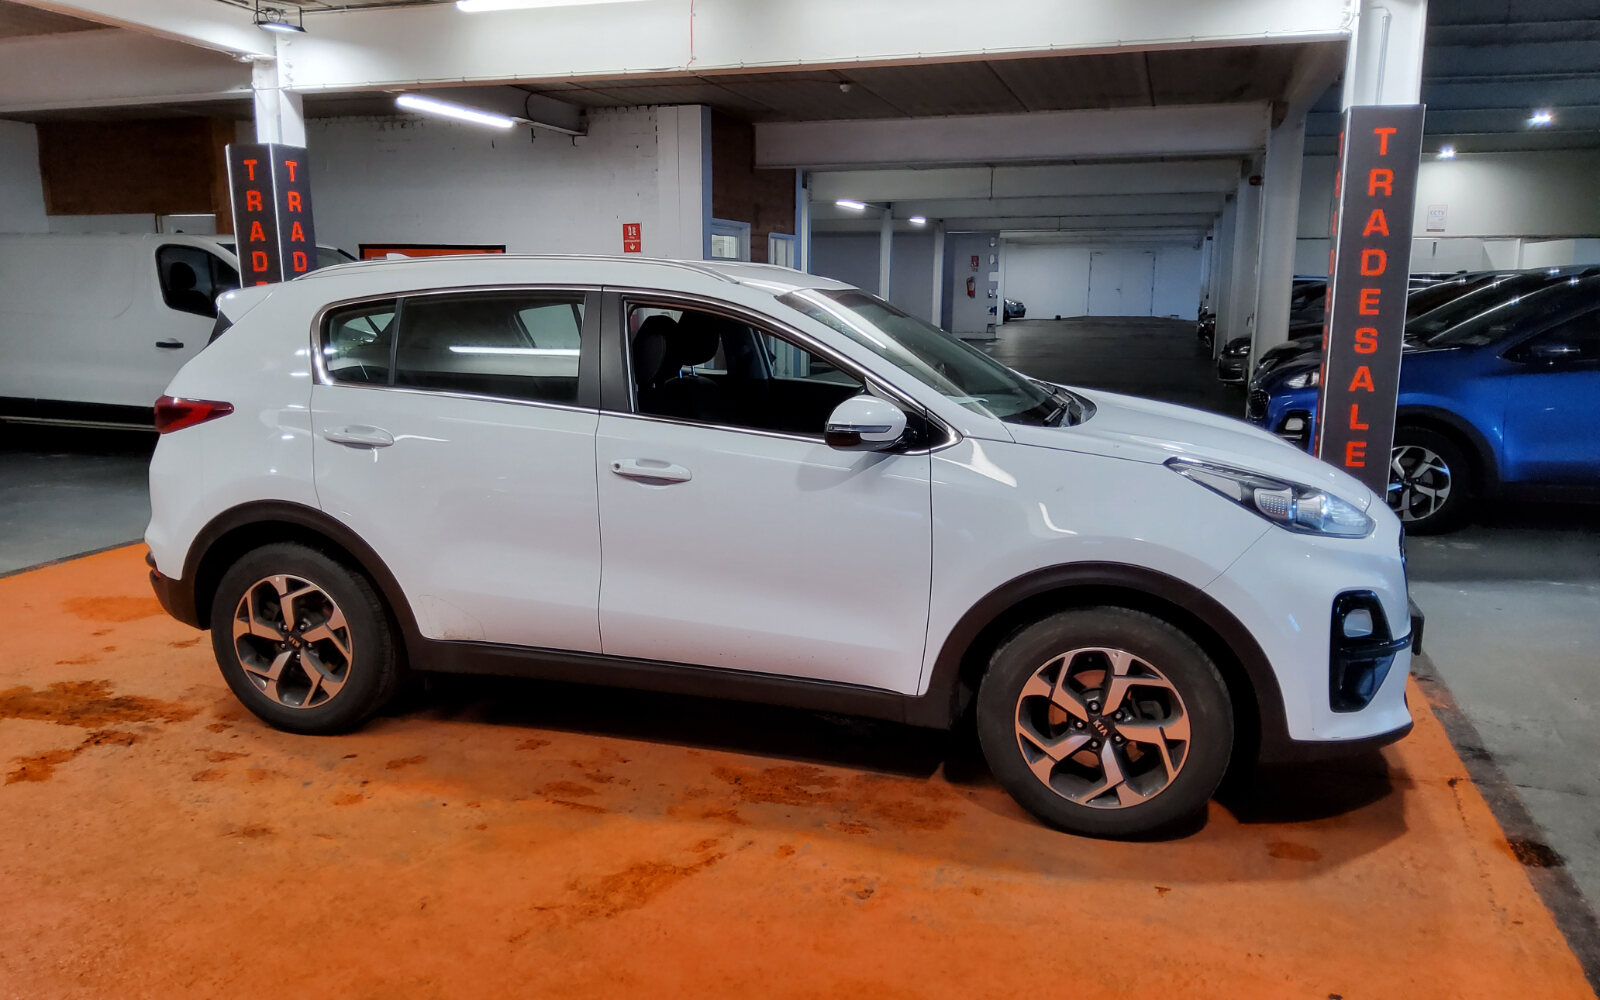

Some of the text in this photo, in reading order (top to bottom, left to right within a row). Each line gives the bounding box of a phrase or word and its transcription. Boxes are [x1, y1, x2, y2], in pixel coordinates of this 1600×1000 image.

[244, 159, 268, 286] TRAD
[1345, 128, 1397, 467] TRADESALE
[1093, 719, 1108, 736] KIA
